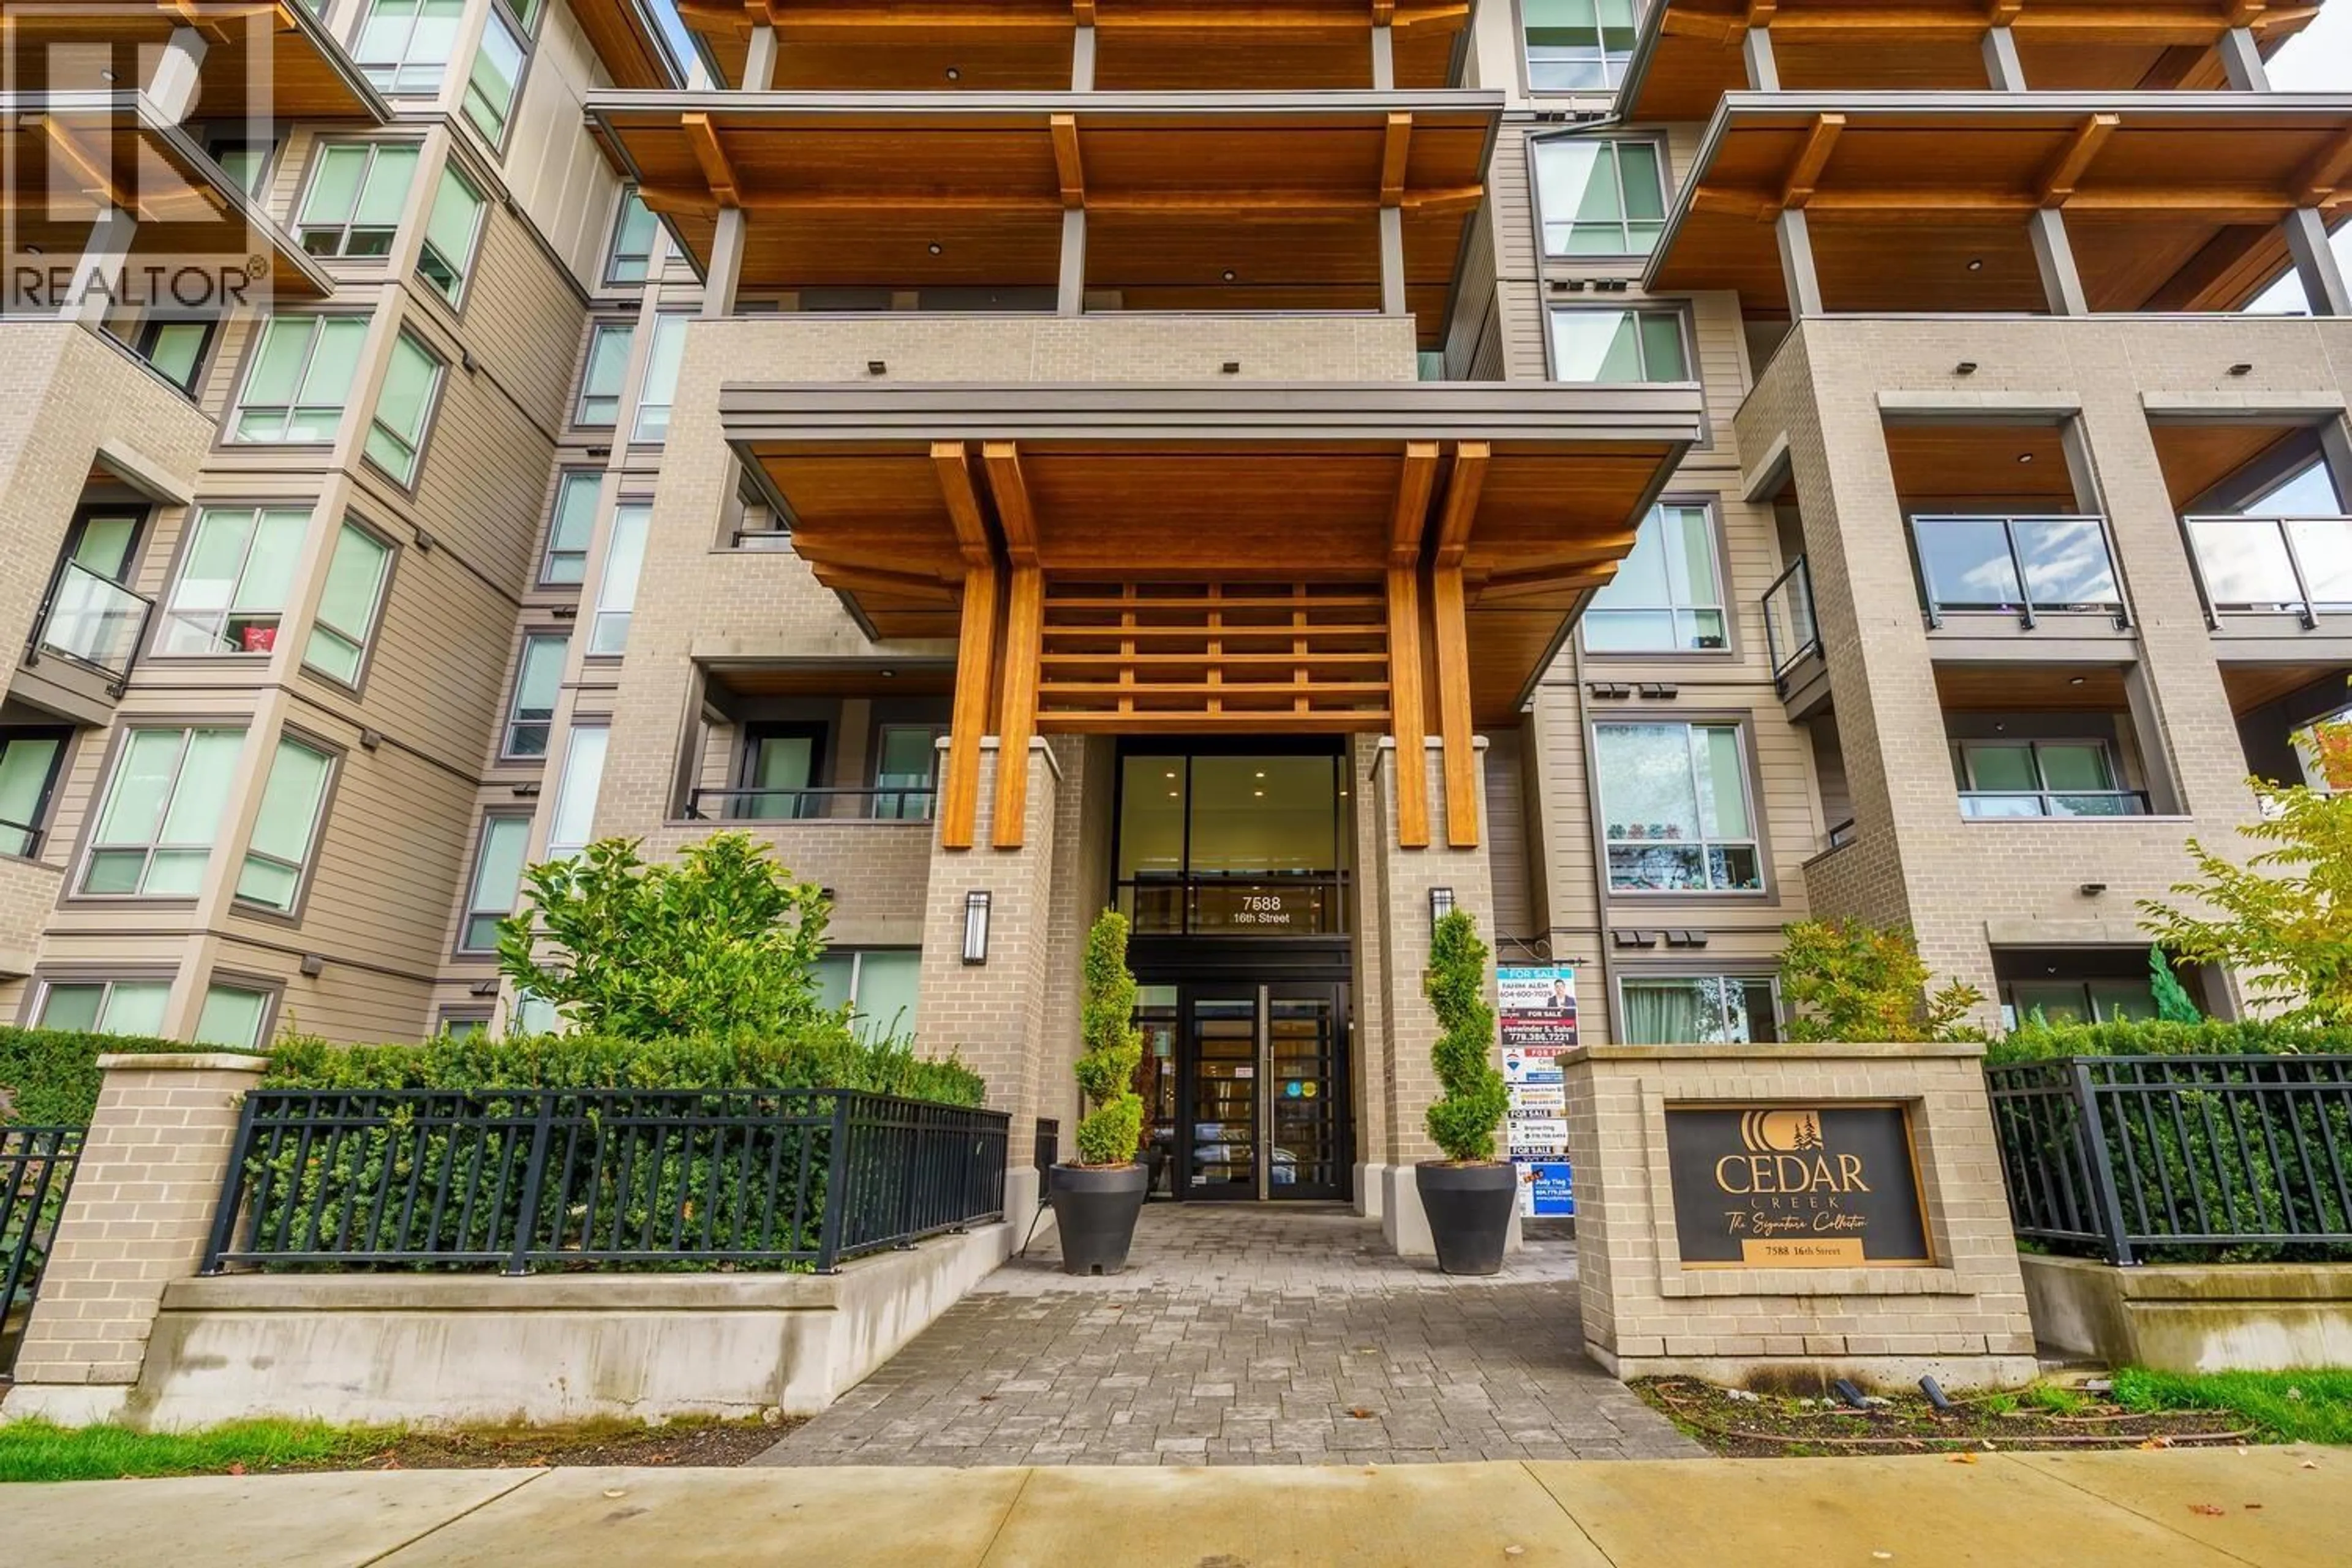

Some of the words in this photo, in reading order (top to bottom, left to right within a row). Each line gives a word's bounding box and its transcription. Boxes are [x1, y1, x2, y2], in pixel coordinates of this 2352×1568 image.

[1242, 897, 1281, 910] 7588
[1234, 913, 1255, 923] 16th
[1258, 913, 1290, 923] Street
[1716, 1154, 1871, 1194] CEDAR
[1751, 1197, 1839, 1209] CREEK
[1724, 1212, 1747, 1235] The
[1752, 1212, 1807, 1236] Signature
[1812, 1212, 1868, 1231] Collection
[1766, 1246, 1790, 1256] 7588
[1794, 1246, 1814, 1256] 16th
[1816, 1246, 1841, 1256] Street
